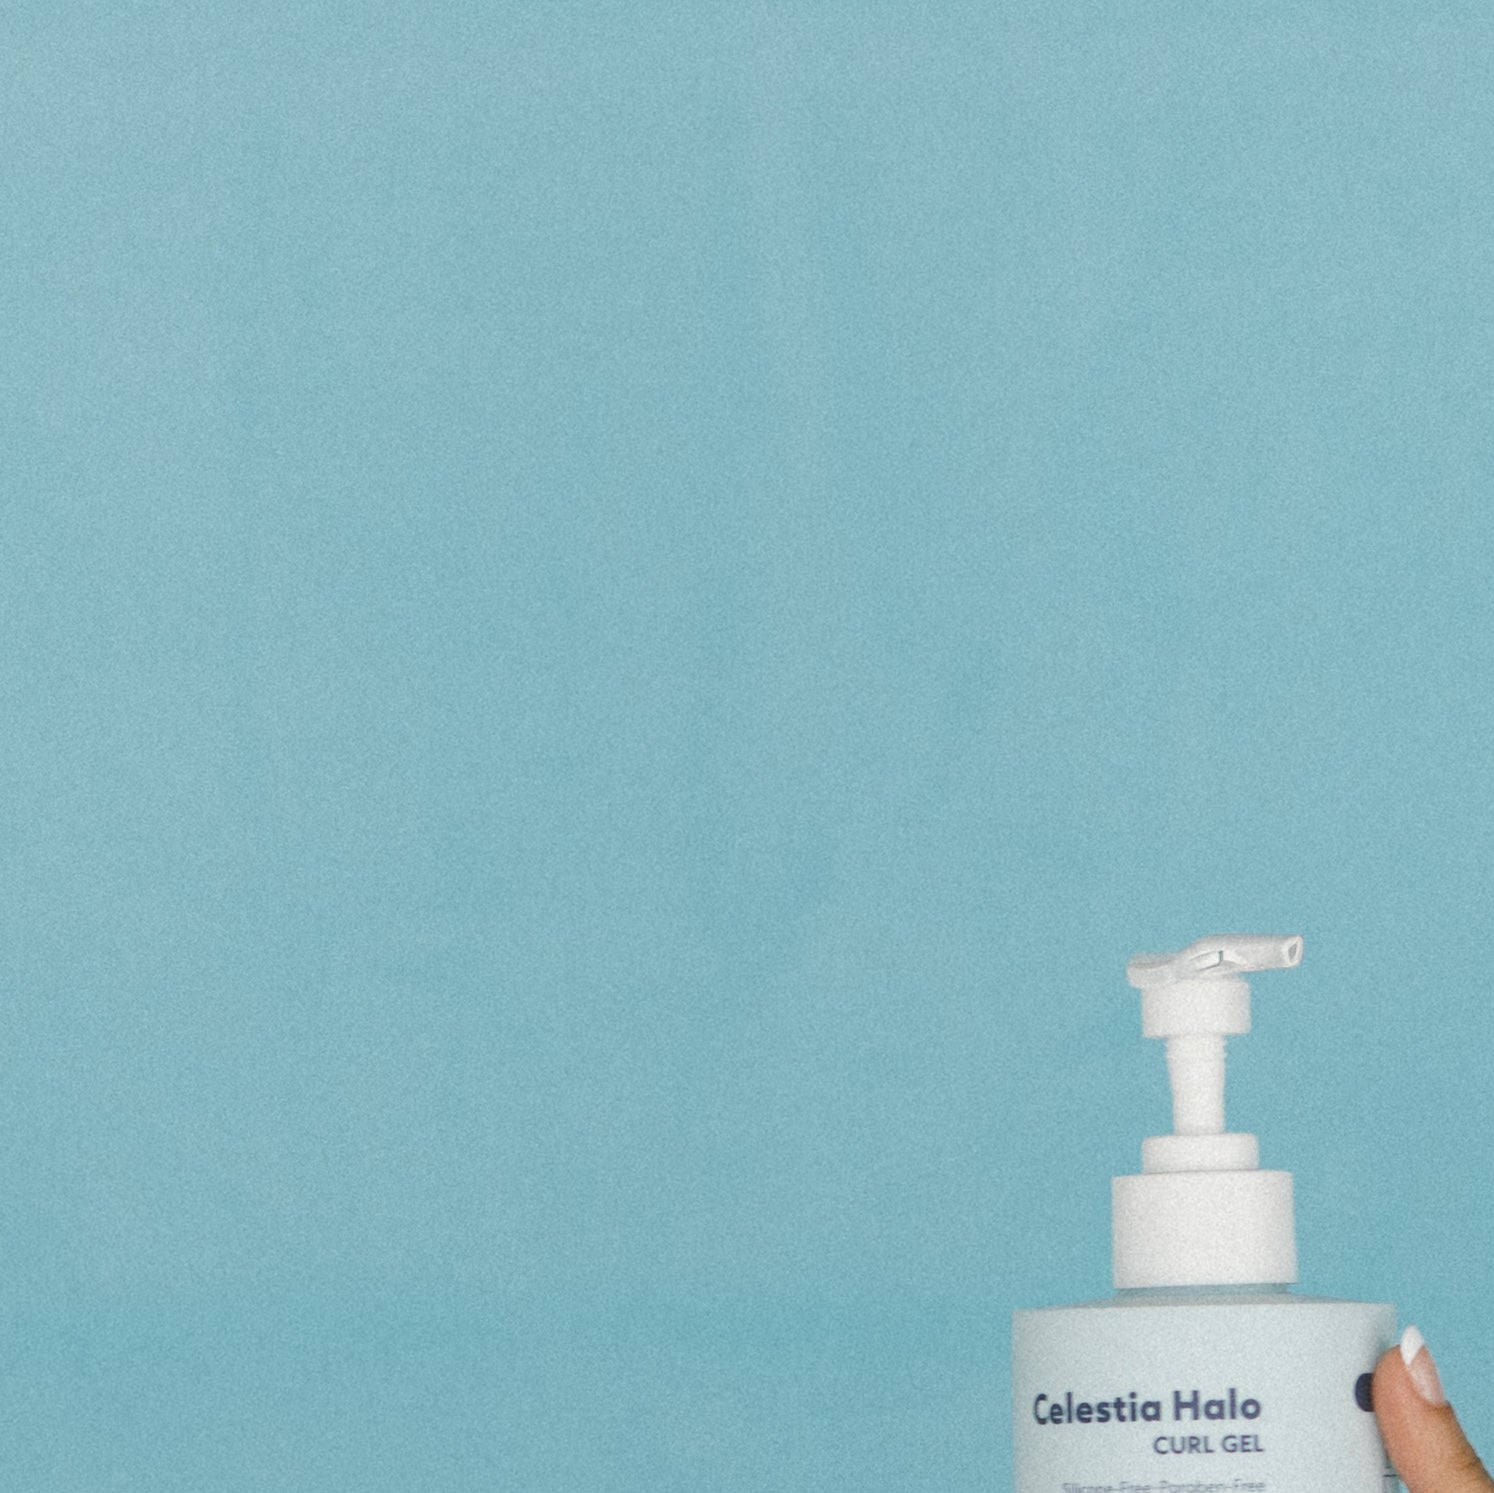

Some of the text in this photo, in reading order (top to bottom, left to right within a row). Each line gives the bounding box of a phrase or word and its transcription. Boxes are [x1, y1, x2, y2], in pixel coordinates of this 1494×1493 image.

[1034, 1387, 1262, 1425] Celestia Halo
[1153, 1434, 1265, 1455] CURL GEL
